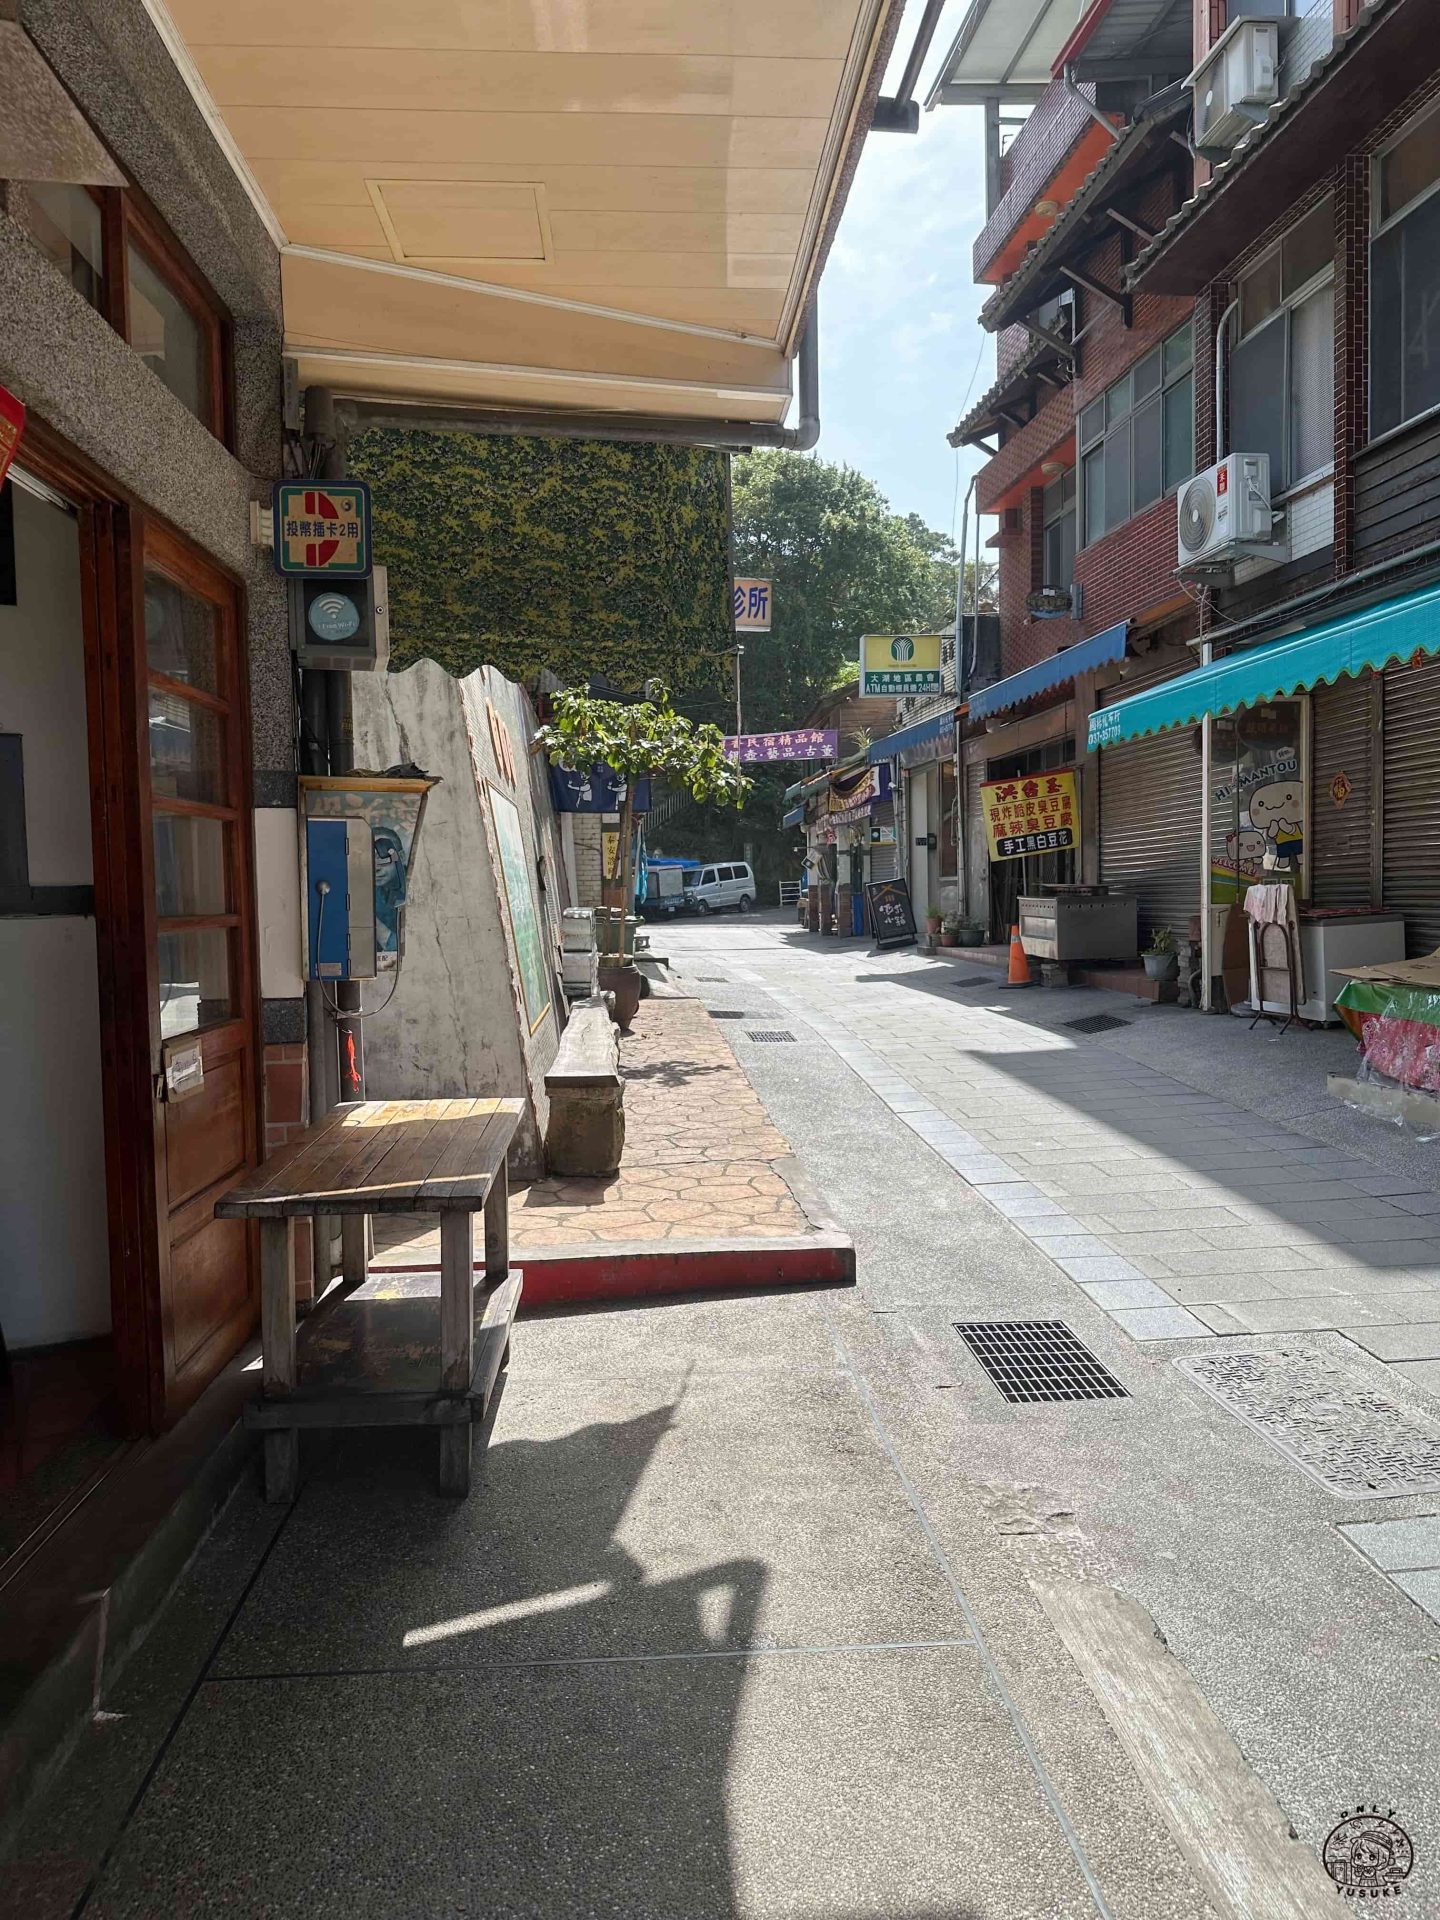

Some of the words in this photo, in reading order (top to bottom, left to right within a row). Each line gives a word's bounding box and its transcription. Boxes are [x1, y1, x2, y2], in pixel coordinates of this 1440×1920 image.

[286, 520, 359, 539] 投幣插卡2用
[990, 795, 1072, 823] 現炸脆皮臭豆腐
[993, 811, 1073, 838] 麻辣臭豆腐
[1004, 830, 1068, 854] 手工黑白豆花
